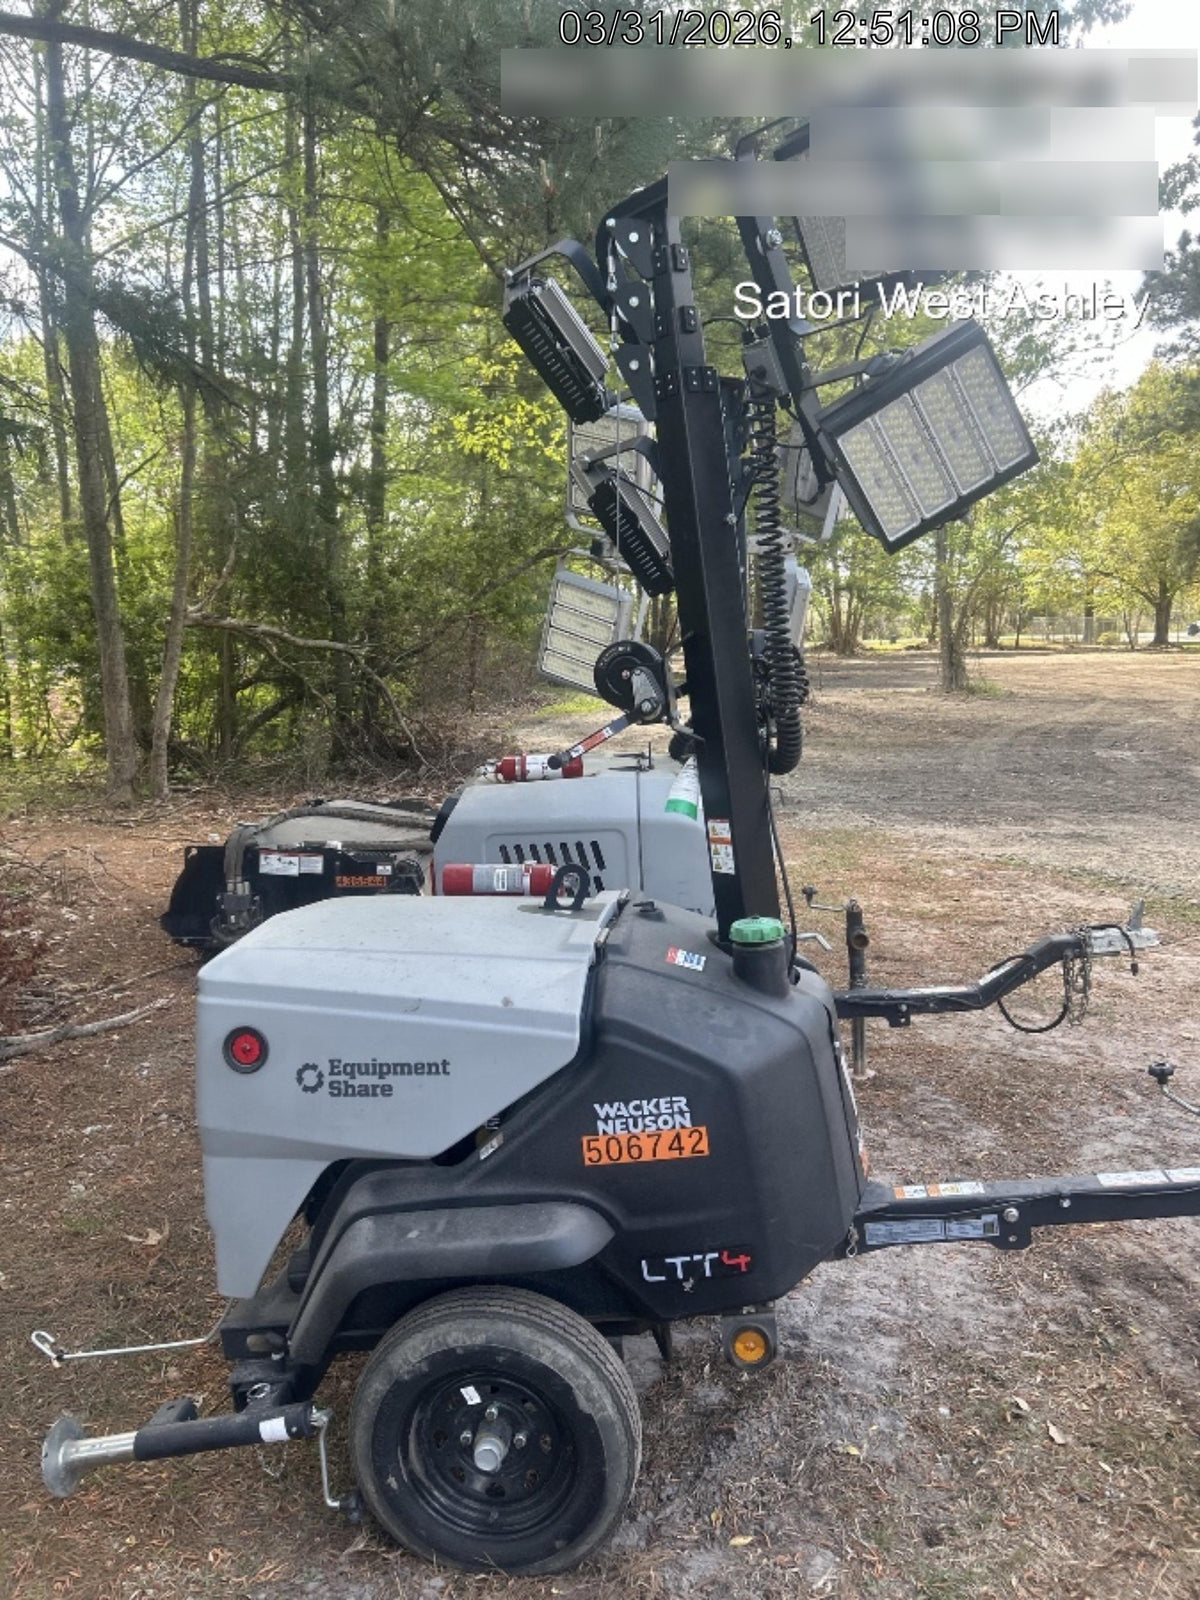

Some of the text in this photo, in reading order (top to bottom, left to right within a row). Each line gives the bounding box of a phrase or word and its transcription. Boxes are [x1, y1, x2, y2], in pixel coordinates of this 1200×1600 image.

[328, 1058, 450, 1080] Equipment
[328, 1080, 393, 1097] Share
[593, 1096, 690, 1119] WACKER
[597, 1112, 692, 1136] NEUSON
[586, 1129, 705, 1164] 506742
